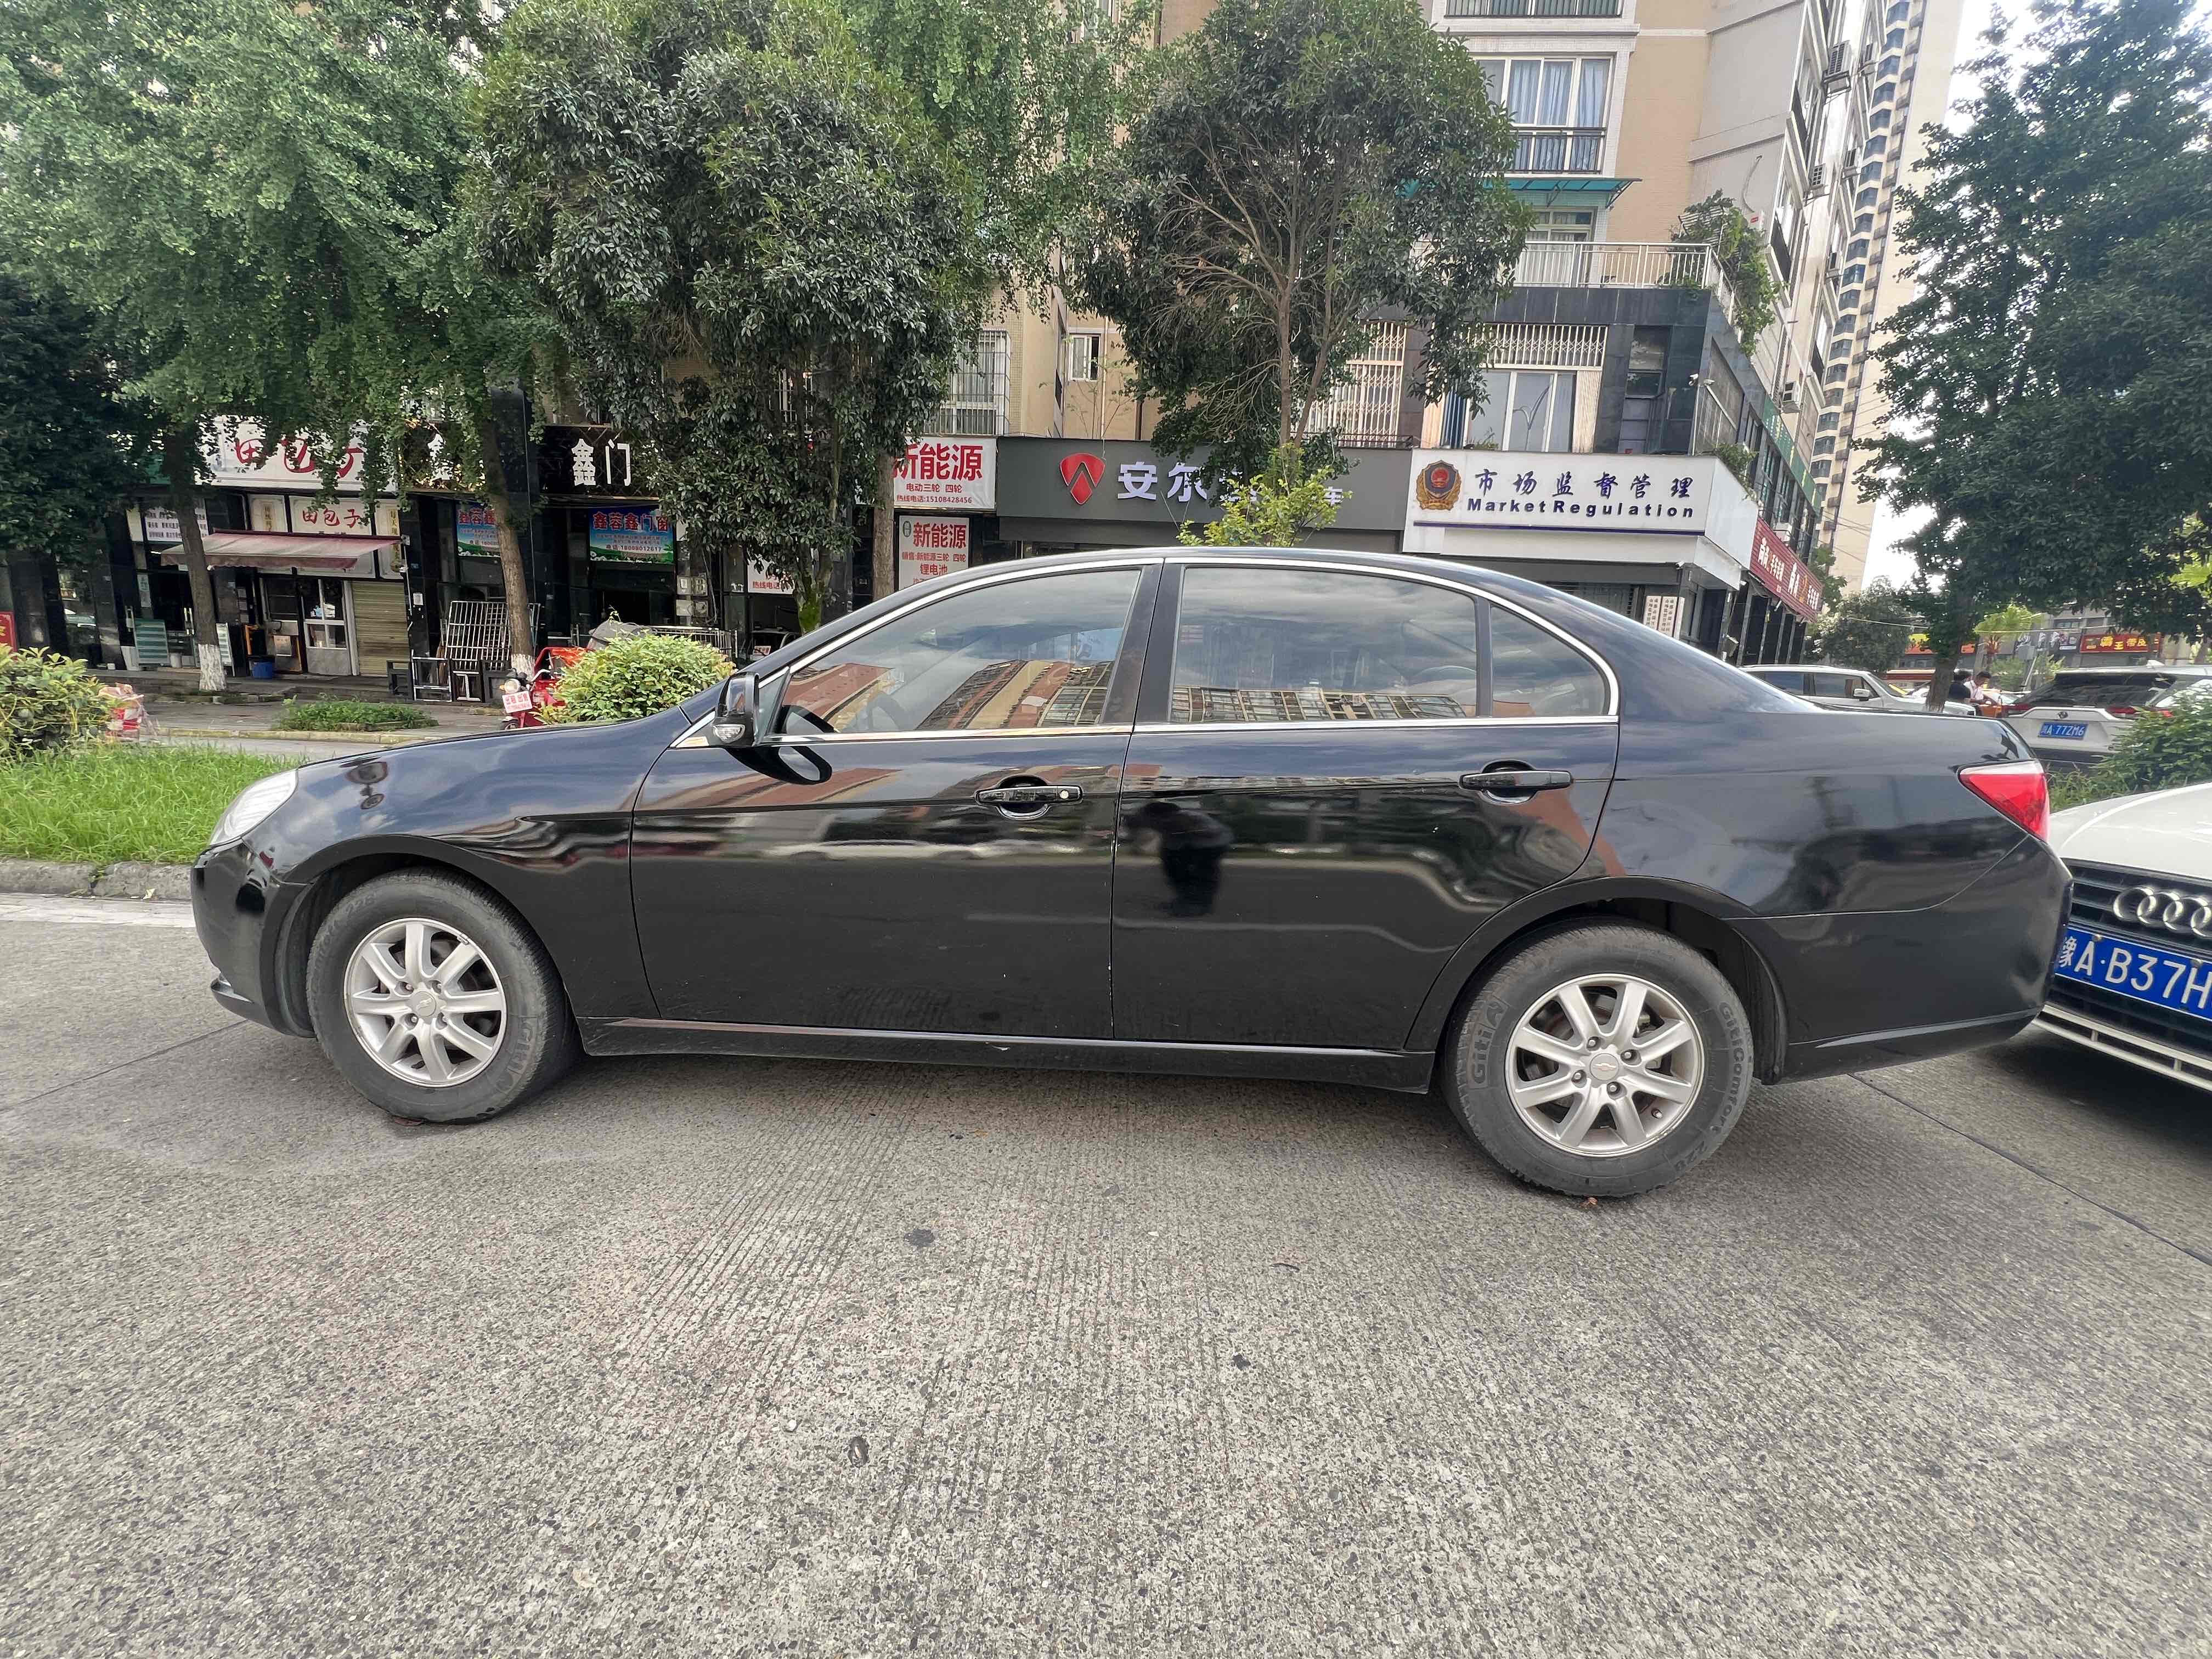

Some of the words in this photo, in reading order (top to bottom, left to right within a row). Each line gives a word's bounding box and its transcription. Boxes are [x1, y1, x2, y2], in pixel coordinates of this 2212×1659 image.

[906, 483, 940, 493] 电动三轮
[945, 484, 962, 493] 四轮
[1475, 468, 1694, 500] 市场监督管理
[302, 508, 361, 528] 田包子
[1467, 498, 1546, 514] Market
[1553, 500, 1694, 518] Regulation
[913, 522, 967, 549] 新能源
[953, 554, 967, 562] 四轮
[920, 563, 948, 575] 锂电池
